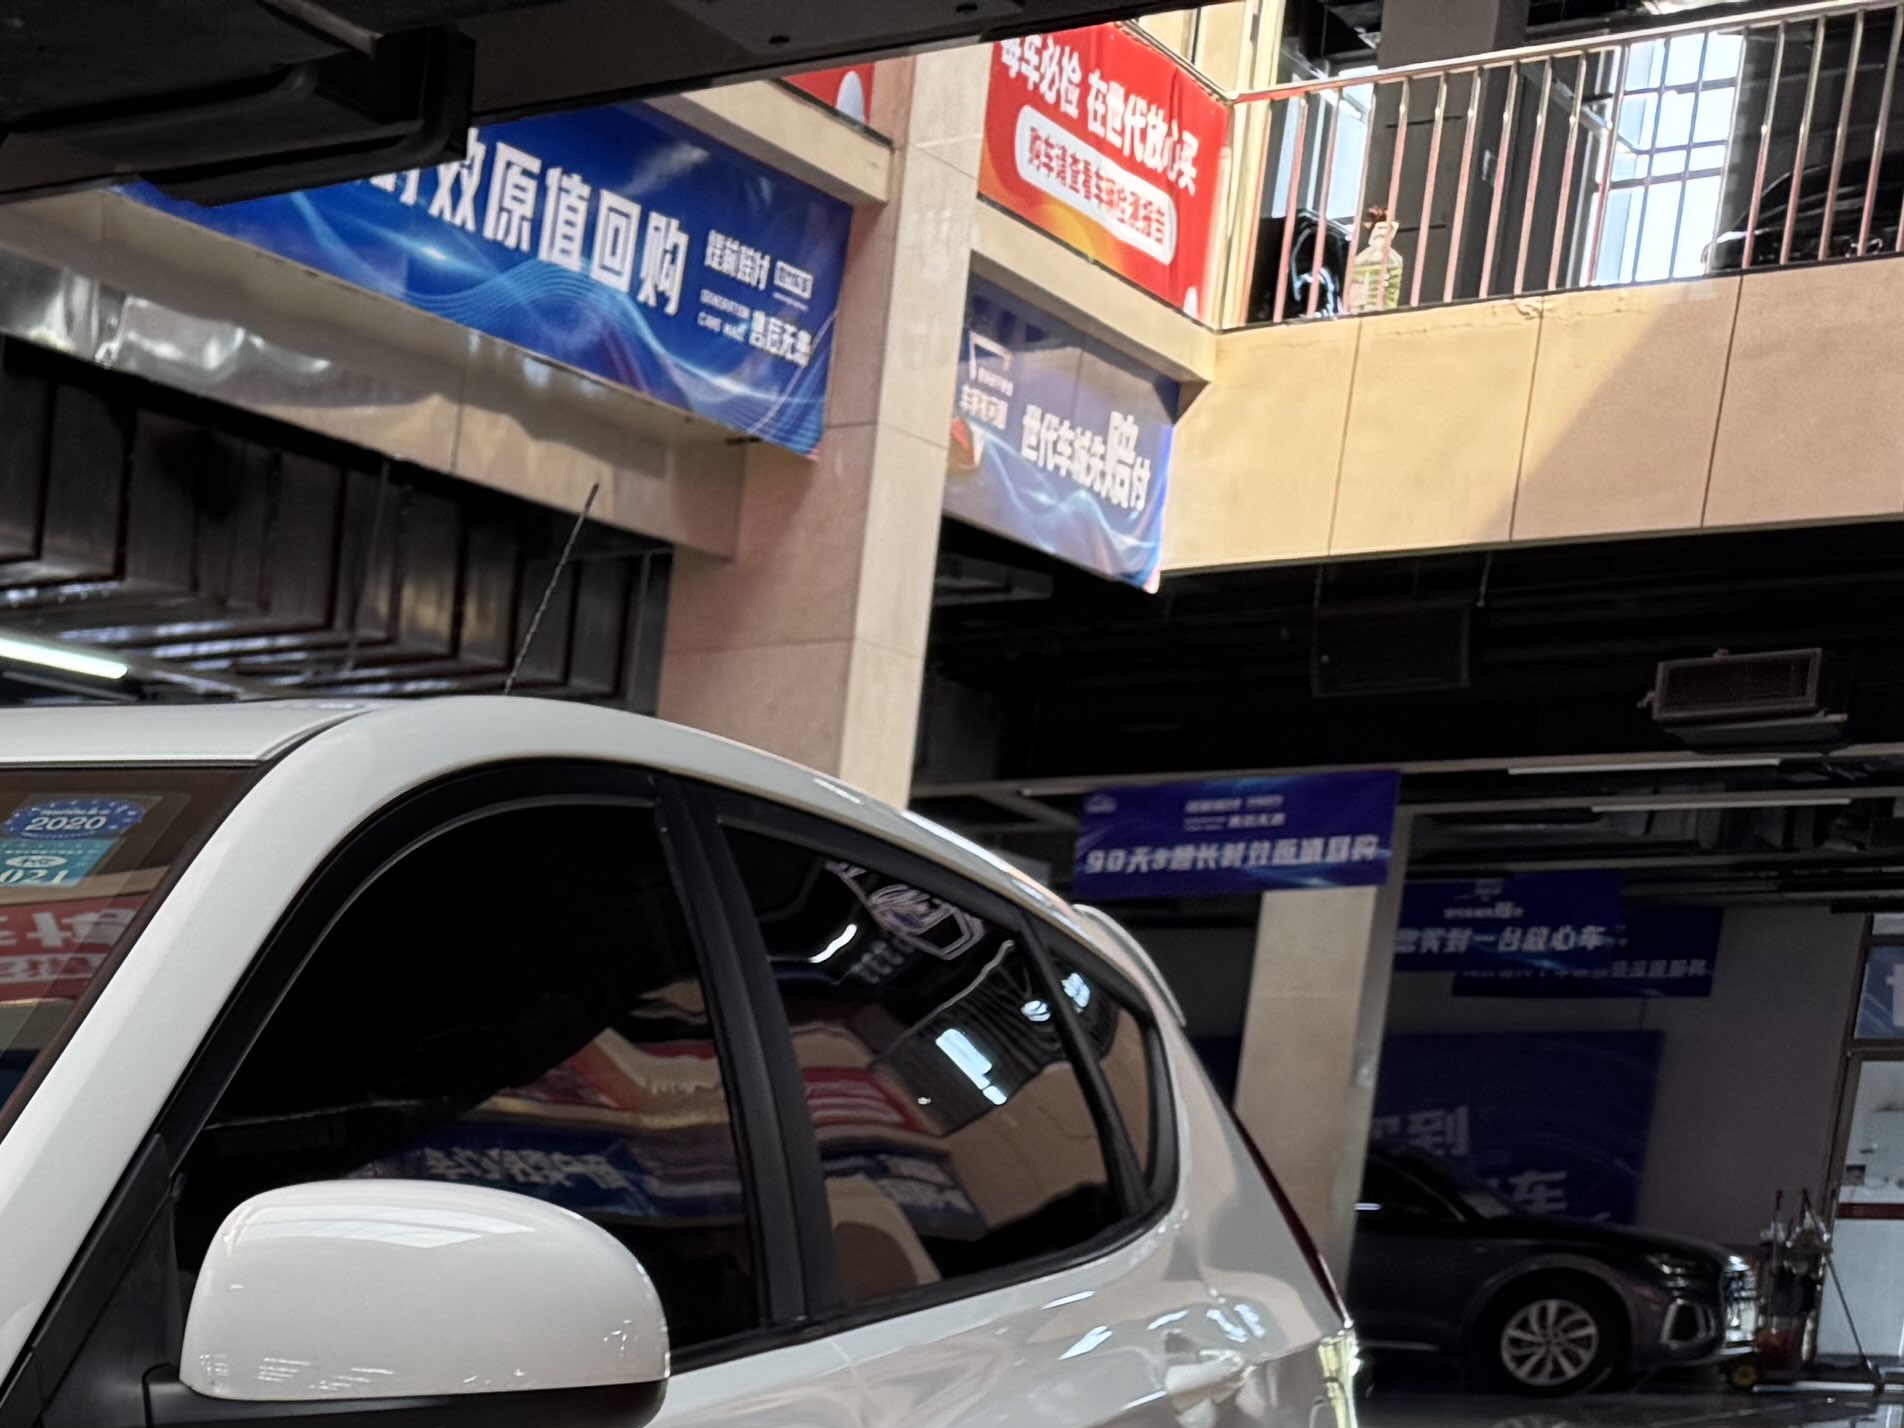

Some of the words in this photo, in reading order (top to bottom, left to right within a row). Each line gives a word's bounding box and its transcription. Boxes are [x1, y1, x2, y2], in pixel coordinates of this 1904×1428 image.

[1087, 69, 1200, 196] 在世代放心买
[369, 127, 690, 315] 效原值回购
[24, 815, 108, 832] 2020
